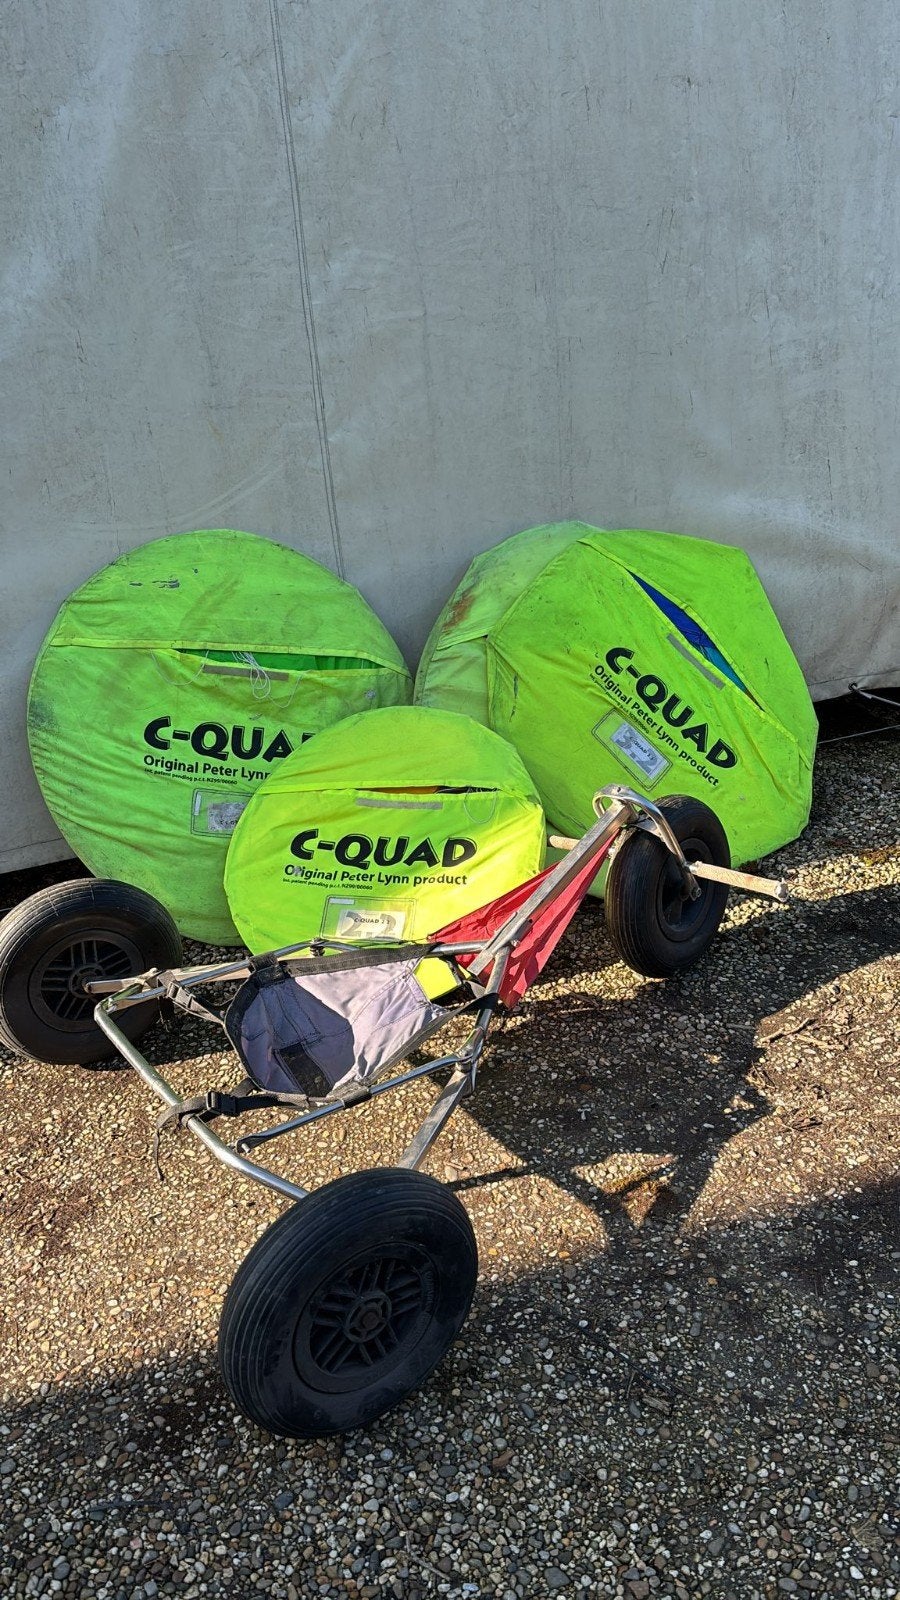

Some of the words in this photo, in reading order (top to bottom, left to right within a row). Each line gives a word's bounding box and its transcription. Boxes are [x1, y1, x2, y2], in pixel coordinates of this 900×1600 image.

[595, 665, 632, 704] Original
[631, 702, 657, 728] Peter
[656, 725, 679, 751] Lynn
[679, 750, 719, 786] product
[605, 647, 738, 769] C-QUAD
[143, 715, 316, 763] C-QUA
[143, 755, 199, 774] Original
[203, 763, 239, 778] Peter
[172, 773, 193, 782] pending
[290, 828, 478, 870] C-QUAD
[341, 871, 375, 882] Peter
[377, 872, 409, 886] Lynn
[413, 874, 467, 887] product
